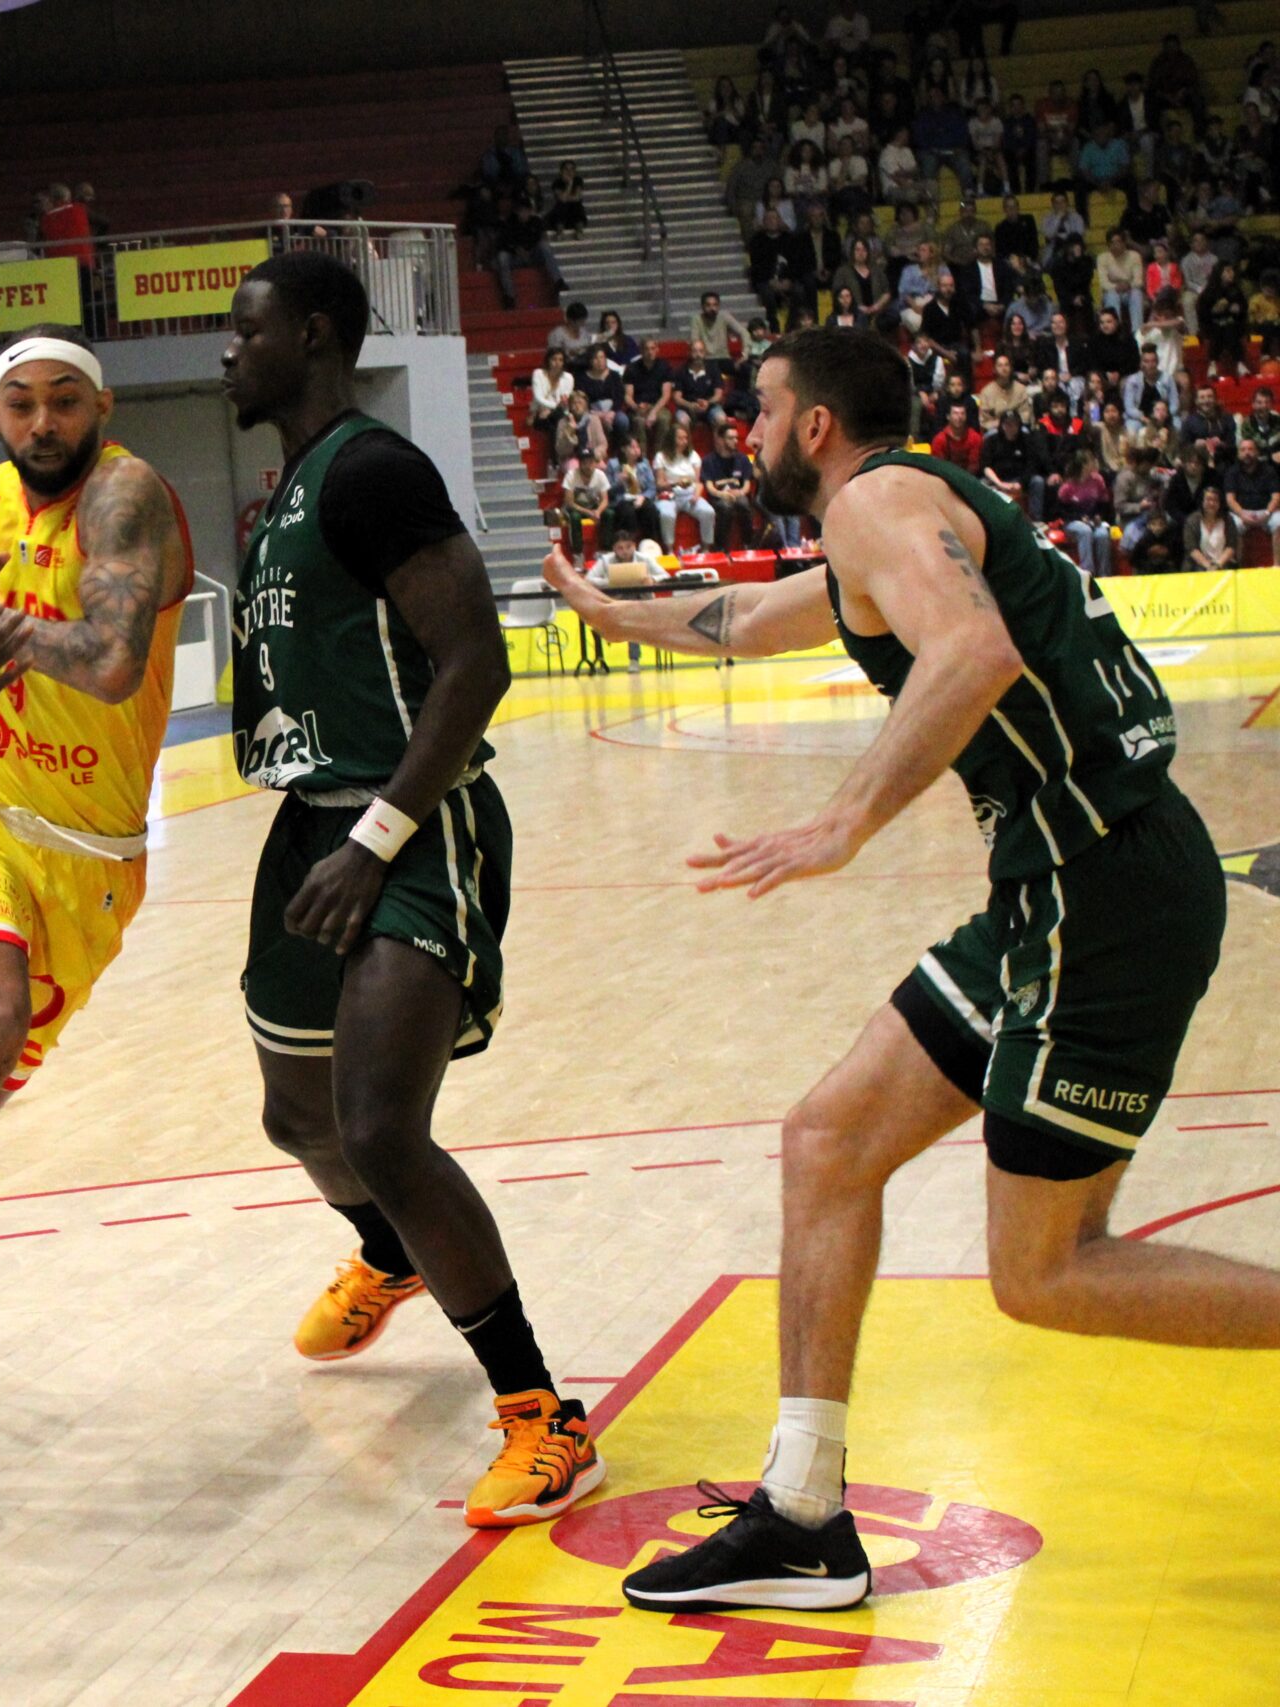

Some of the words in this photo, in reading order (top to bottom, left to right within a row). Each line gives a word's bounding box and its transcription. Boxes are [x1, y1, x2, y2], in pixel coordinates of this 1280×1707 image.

[259, 642, 275, 691] 9
[413, 936, 447, 958] MSD
[1054, 1078, 1150, 1114] REALITES
